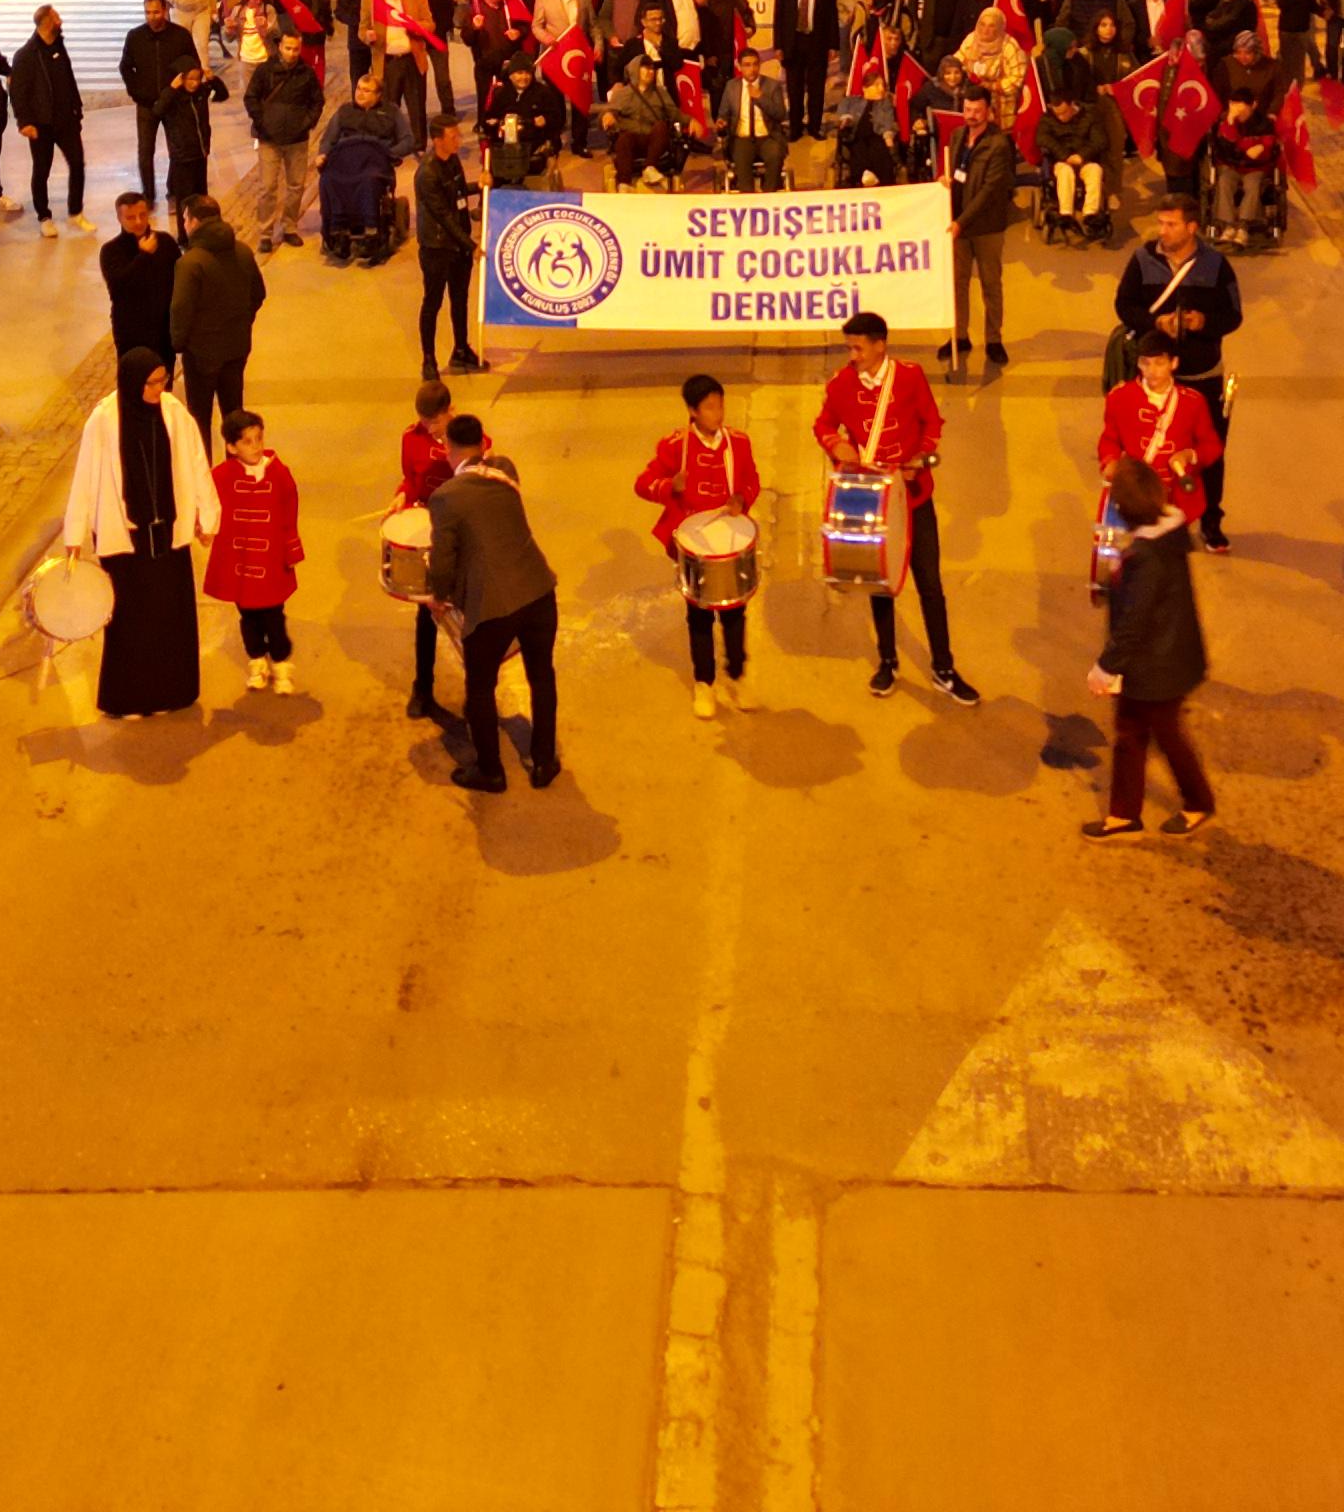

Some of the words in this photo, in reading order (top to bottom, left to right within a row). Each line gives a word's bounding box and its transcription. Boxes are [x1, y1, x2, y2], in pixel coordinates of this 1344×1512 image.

[687, 201, 882, 241] SEYDİŞEHİR
[640, 242, 722, 278] ÜMİT
[737, 239, 931, 283] ÇOCUKLARI
[711, 281, 863, 322] DERNEĞİ
